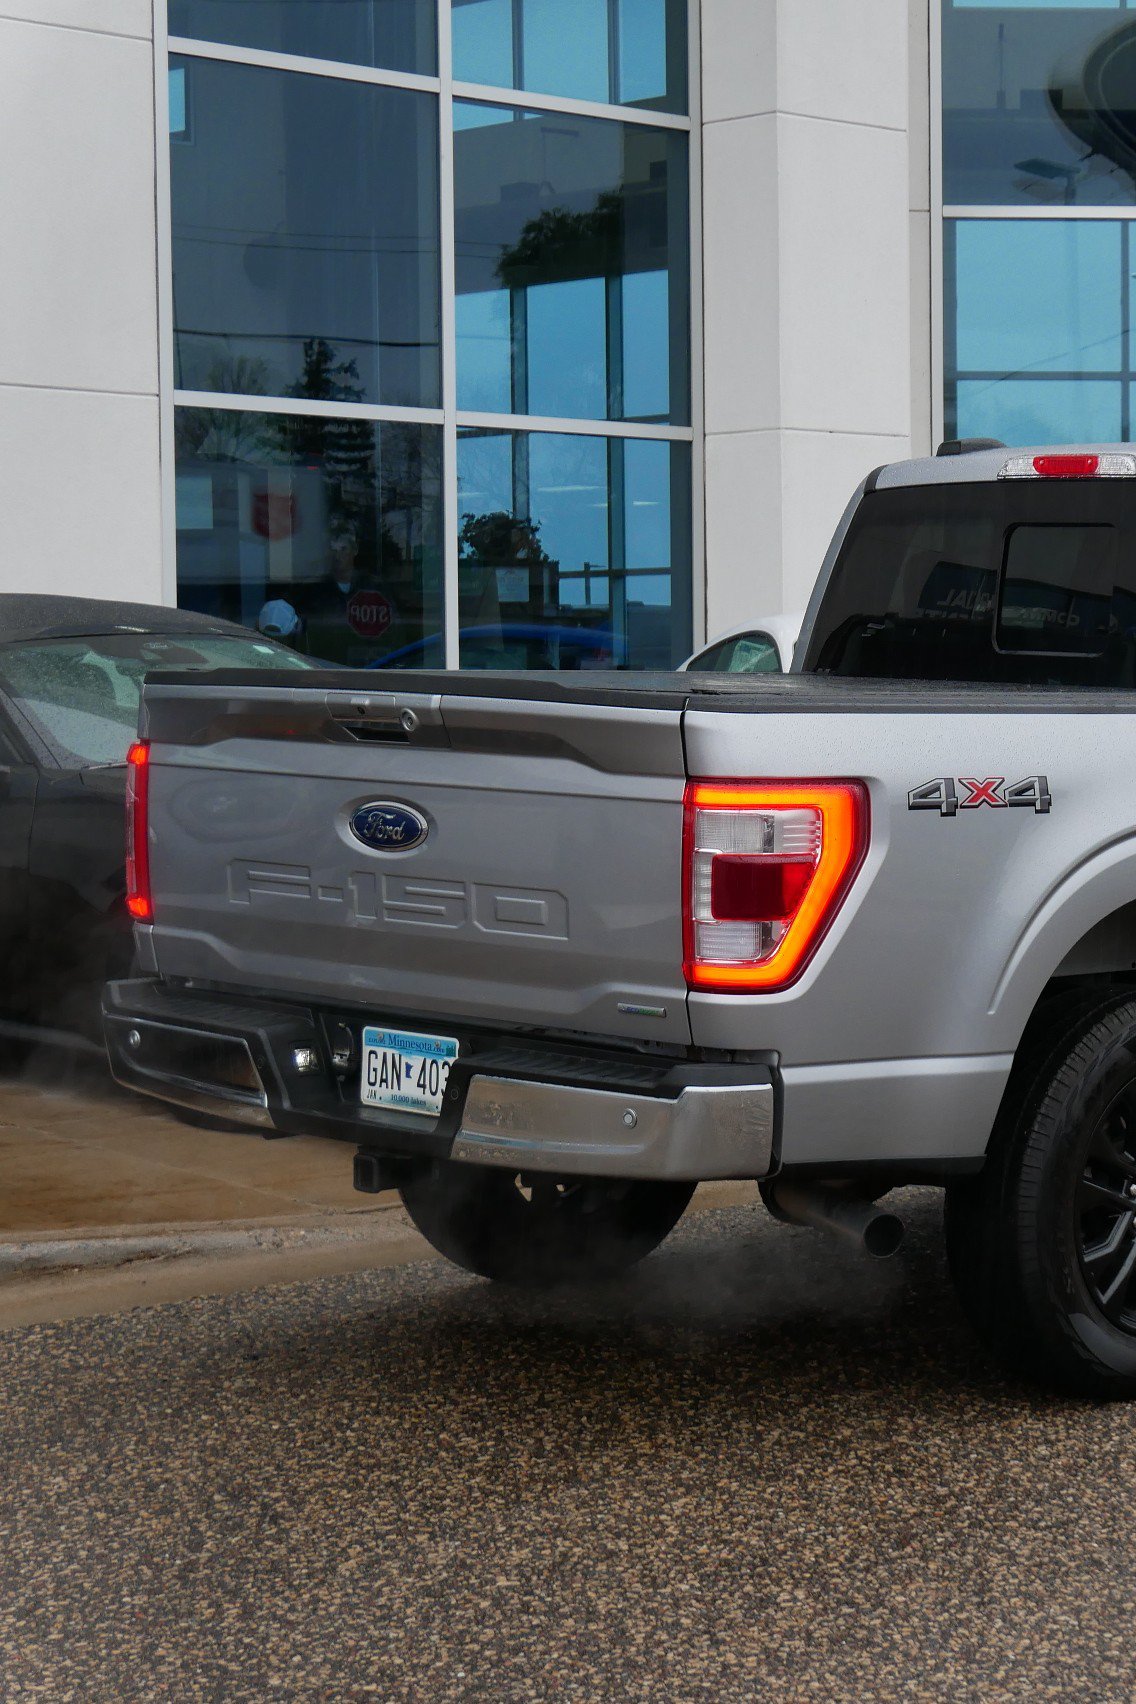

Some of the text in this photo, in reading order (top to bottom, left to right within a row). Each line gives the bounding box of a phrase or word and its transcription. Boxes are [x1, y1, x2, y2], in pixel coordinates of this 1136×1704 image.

[363, 810, 407, 841] Ford
[226, 858, 570, 941] F-150
[367, 1049, 402, 1092] GAN
